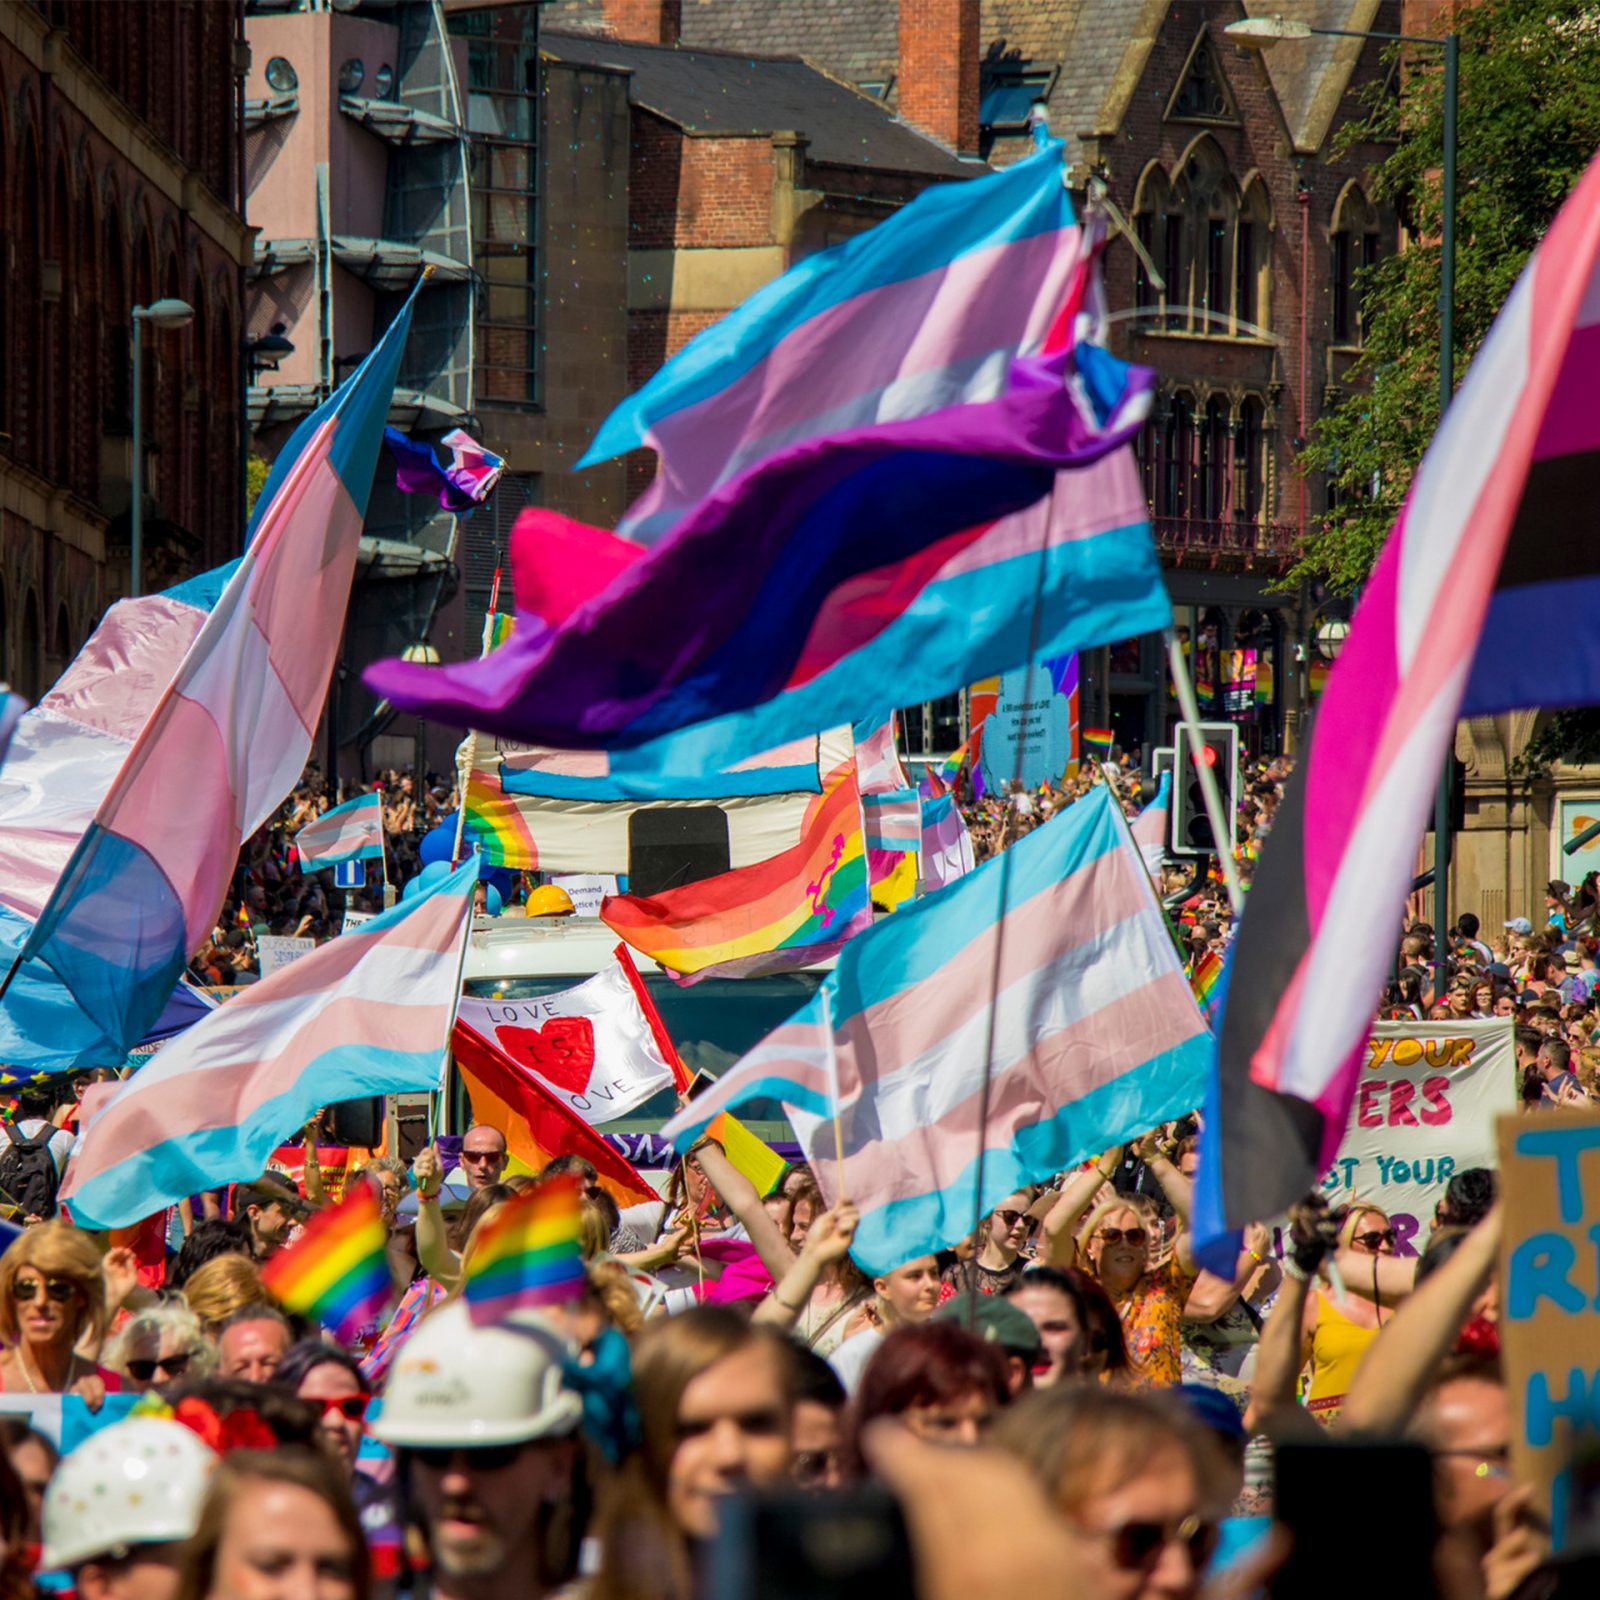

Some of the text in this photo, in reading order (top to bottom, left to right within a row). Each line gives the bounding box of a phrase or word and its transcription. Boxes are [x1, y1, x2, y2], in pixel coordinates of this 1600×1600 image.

[568, 886, 602, 895] Demand
[486, 1001, 560, 1023] LOVE
[528, 1038, 572, 1064] IS
[1367, 1037, 1476, 1070] YOUR
[1376, 1155, 1455, 1185] YOUR
